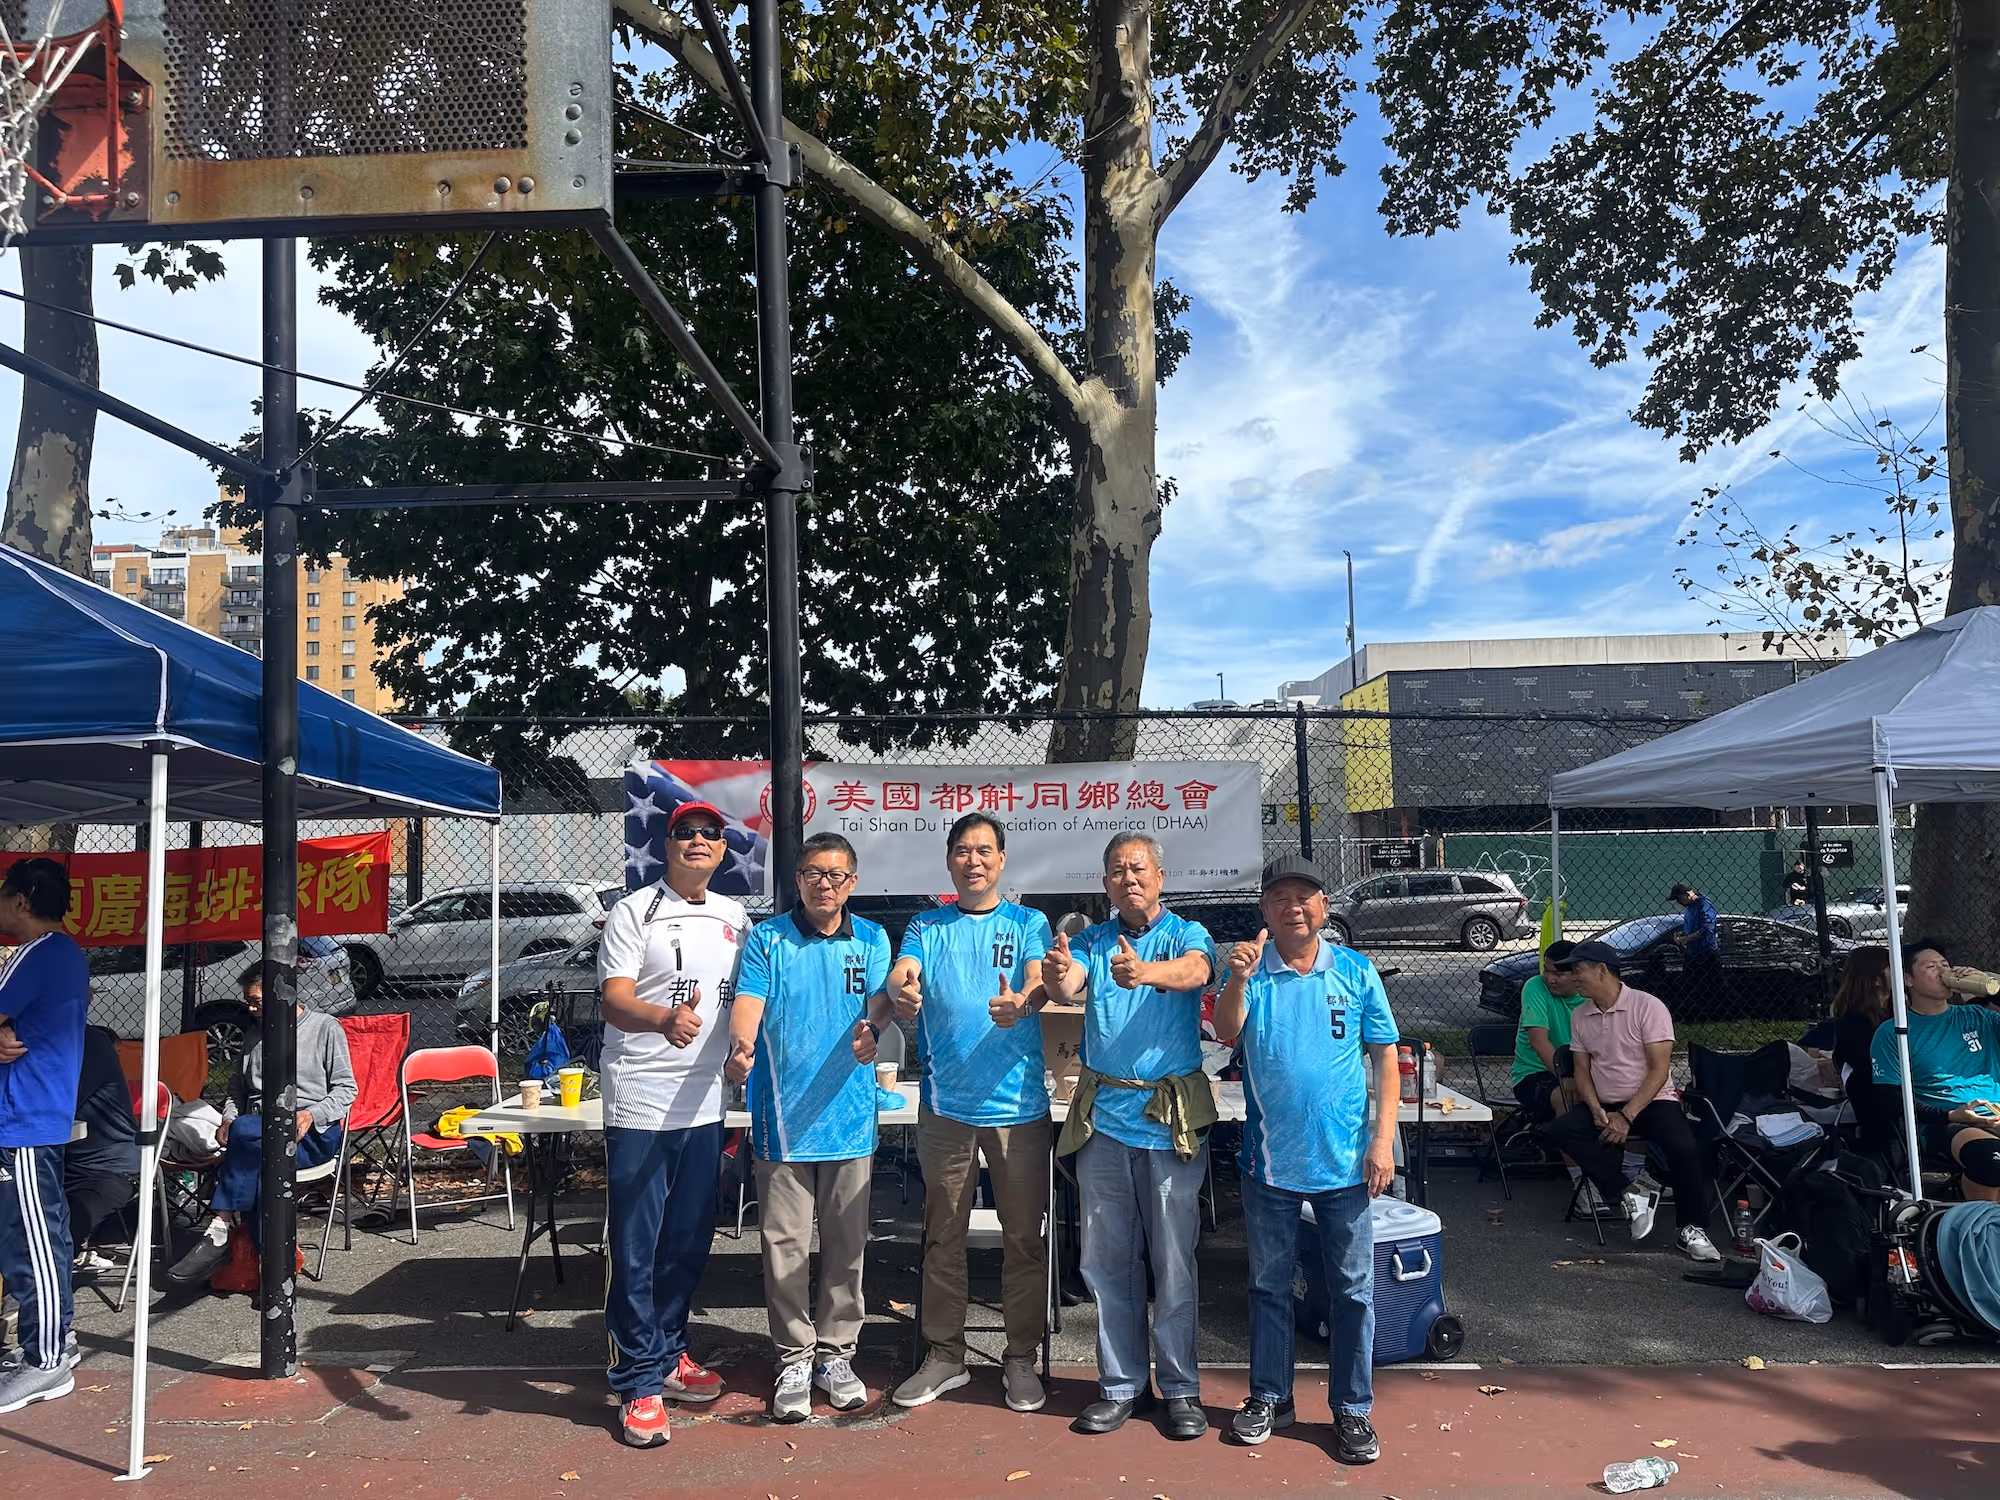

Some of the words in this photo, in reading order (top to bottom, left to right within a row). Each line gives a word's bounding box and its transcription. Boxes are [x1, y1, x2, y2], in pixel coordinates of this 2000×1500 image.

[827, 779, 1218, 813] 美國都斛同鄉總會
[839, 817, 863, 832] Tai
[869, 817, 908, 832] Shan
[915, 817, 936, 832] Du
[999, 816, 1057, 832] ociation
[1063, 815, 1077, 831] of
[1083, 815, 1146, 831] America
[1152, 813, 1209, 833] (DHAA)
[670, 938, 682, 971] 1
[992, 943, 1014, 969] 16
[843, 967, 866, 994] 15
[1330, 1009, 1346, 1040] 5
[1967, 1038, 1982, 1052] 31
[1736, 1227, 1747, 1238] G
